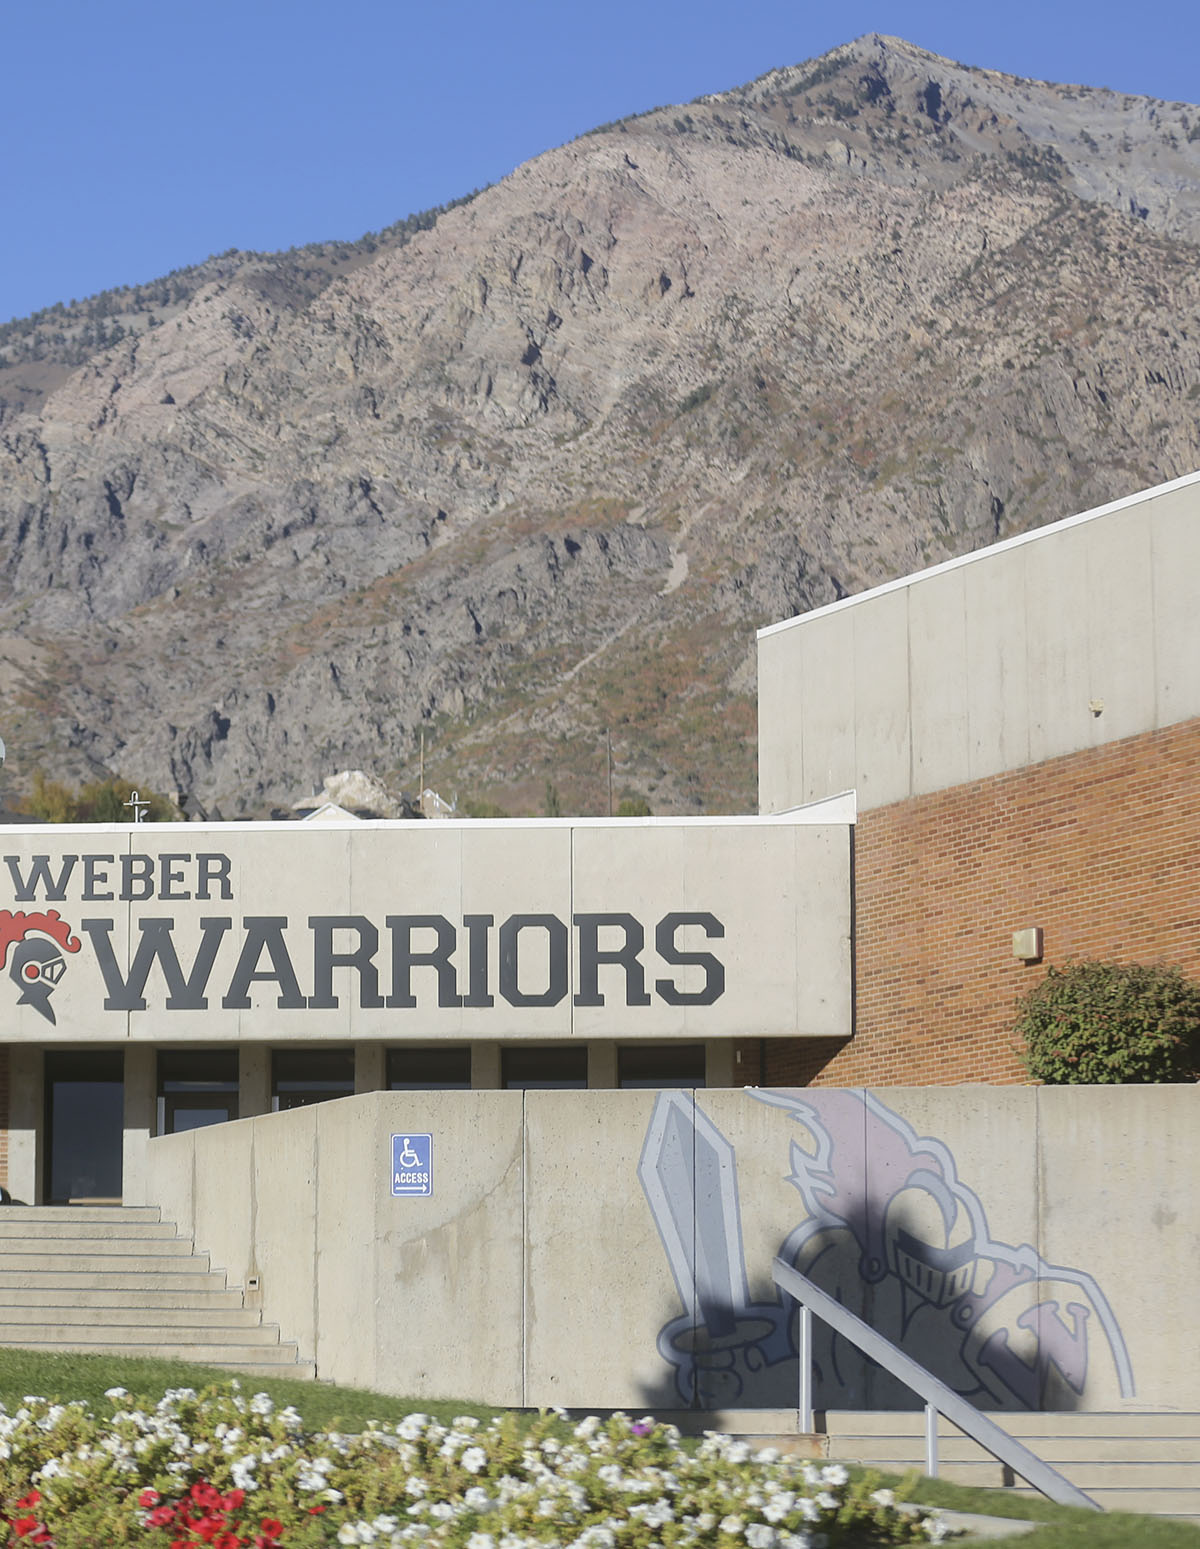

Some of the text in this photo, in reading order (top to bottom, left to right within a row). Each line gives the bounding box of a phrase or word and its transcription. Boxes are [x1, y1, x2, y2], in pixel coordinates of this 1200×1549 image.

[3, 853, 234, 902] WEBER
[81, 911, 726, 1011] WARRIORS
[394, 1172, 429, 1184] ACCESS
